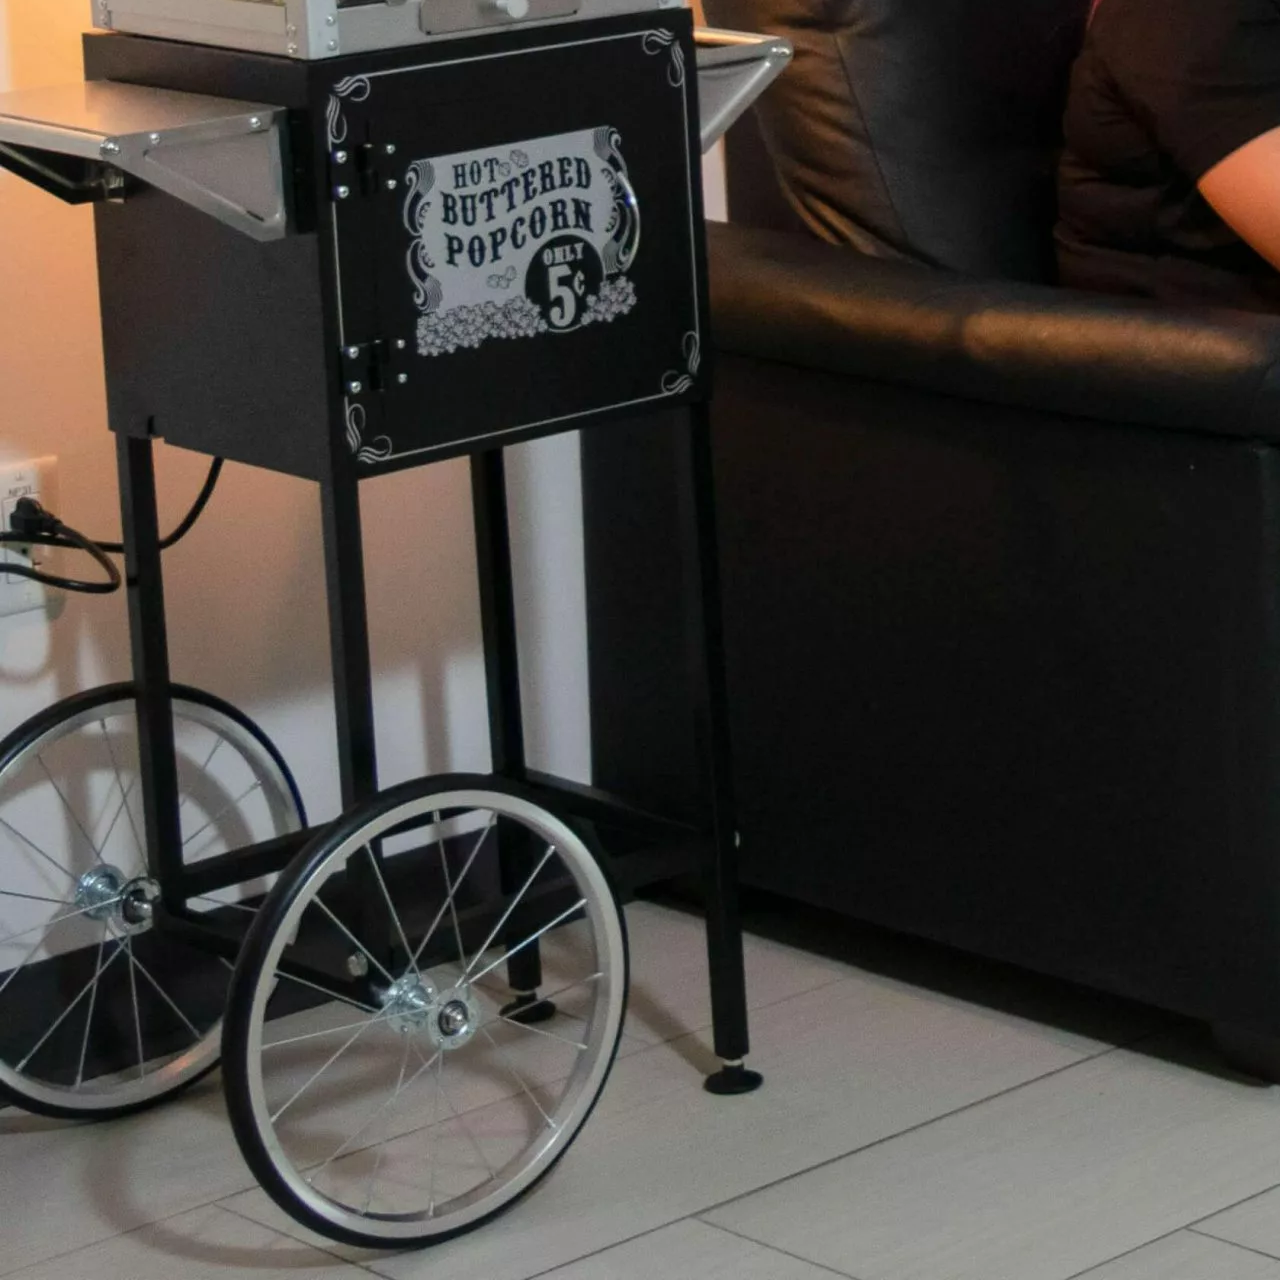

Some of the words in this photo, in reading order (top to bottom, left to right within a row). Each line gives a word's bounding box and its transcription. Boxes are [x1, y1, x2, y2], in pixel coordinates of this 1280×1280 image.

[440, 156, 592, 226] BUTTERED
[452, 157, 500, 190] HOT
[444, 198, 594, 268] POPCORN
[542, 242, 585, 266] ONLY
